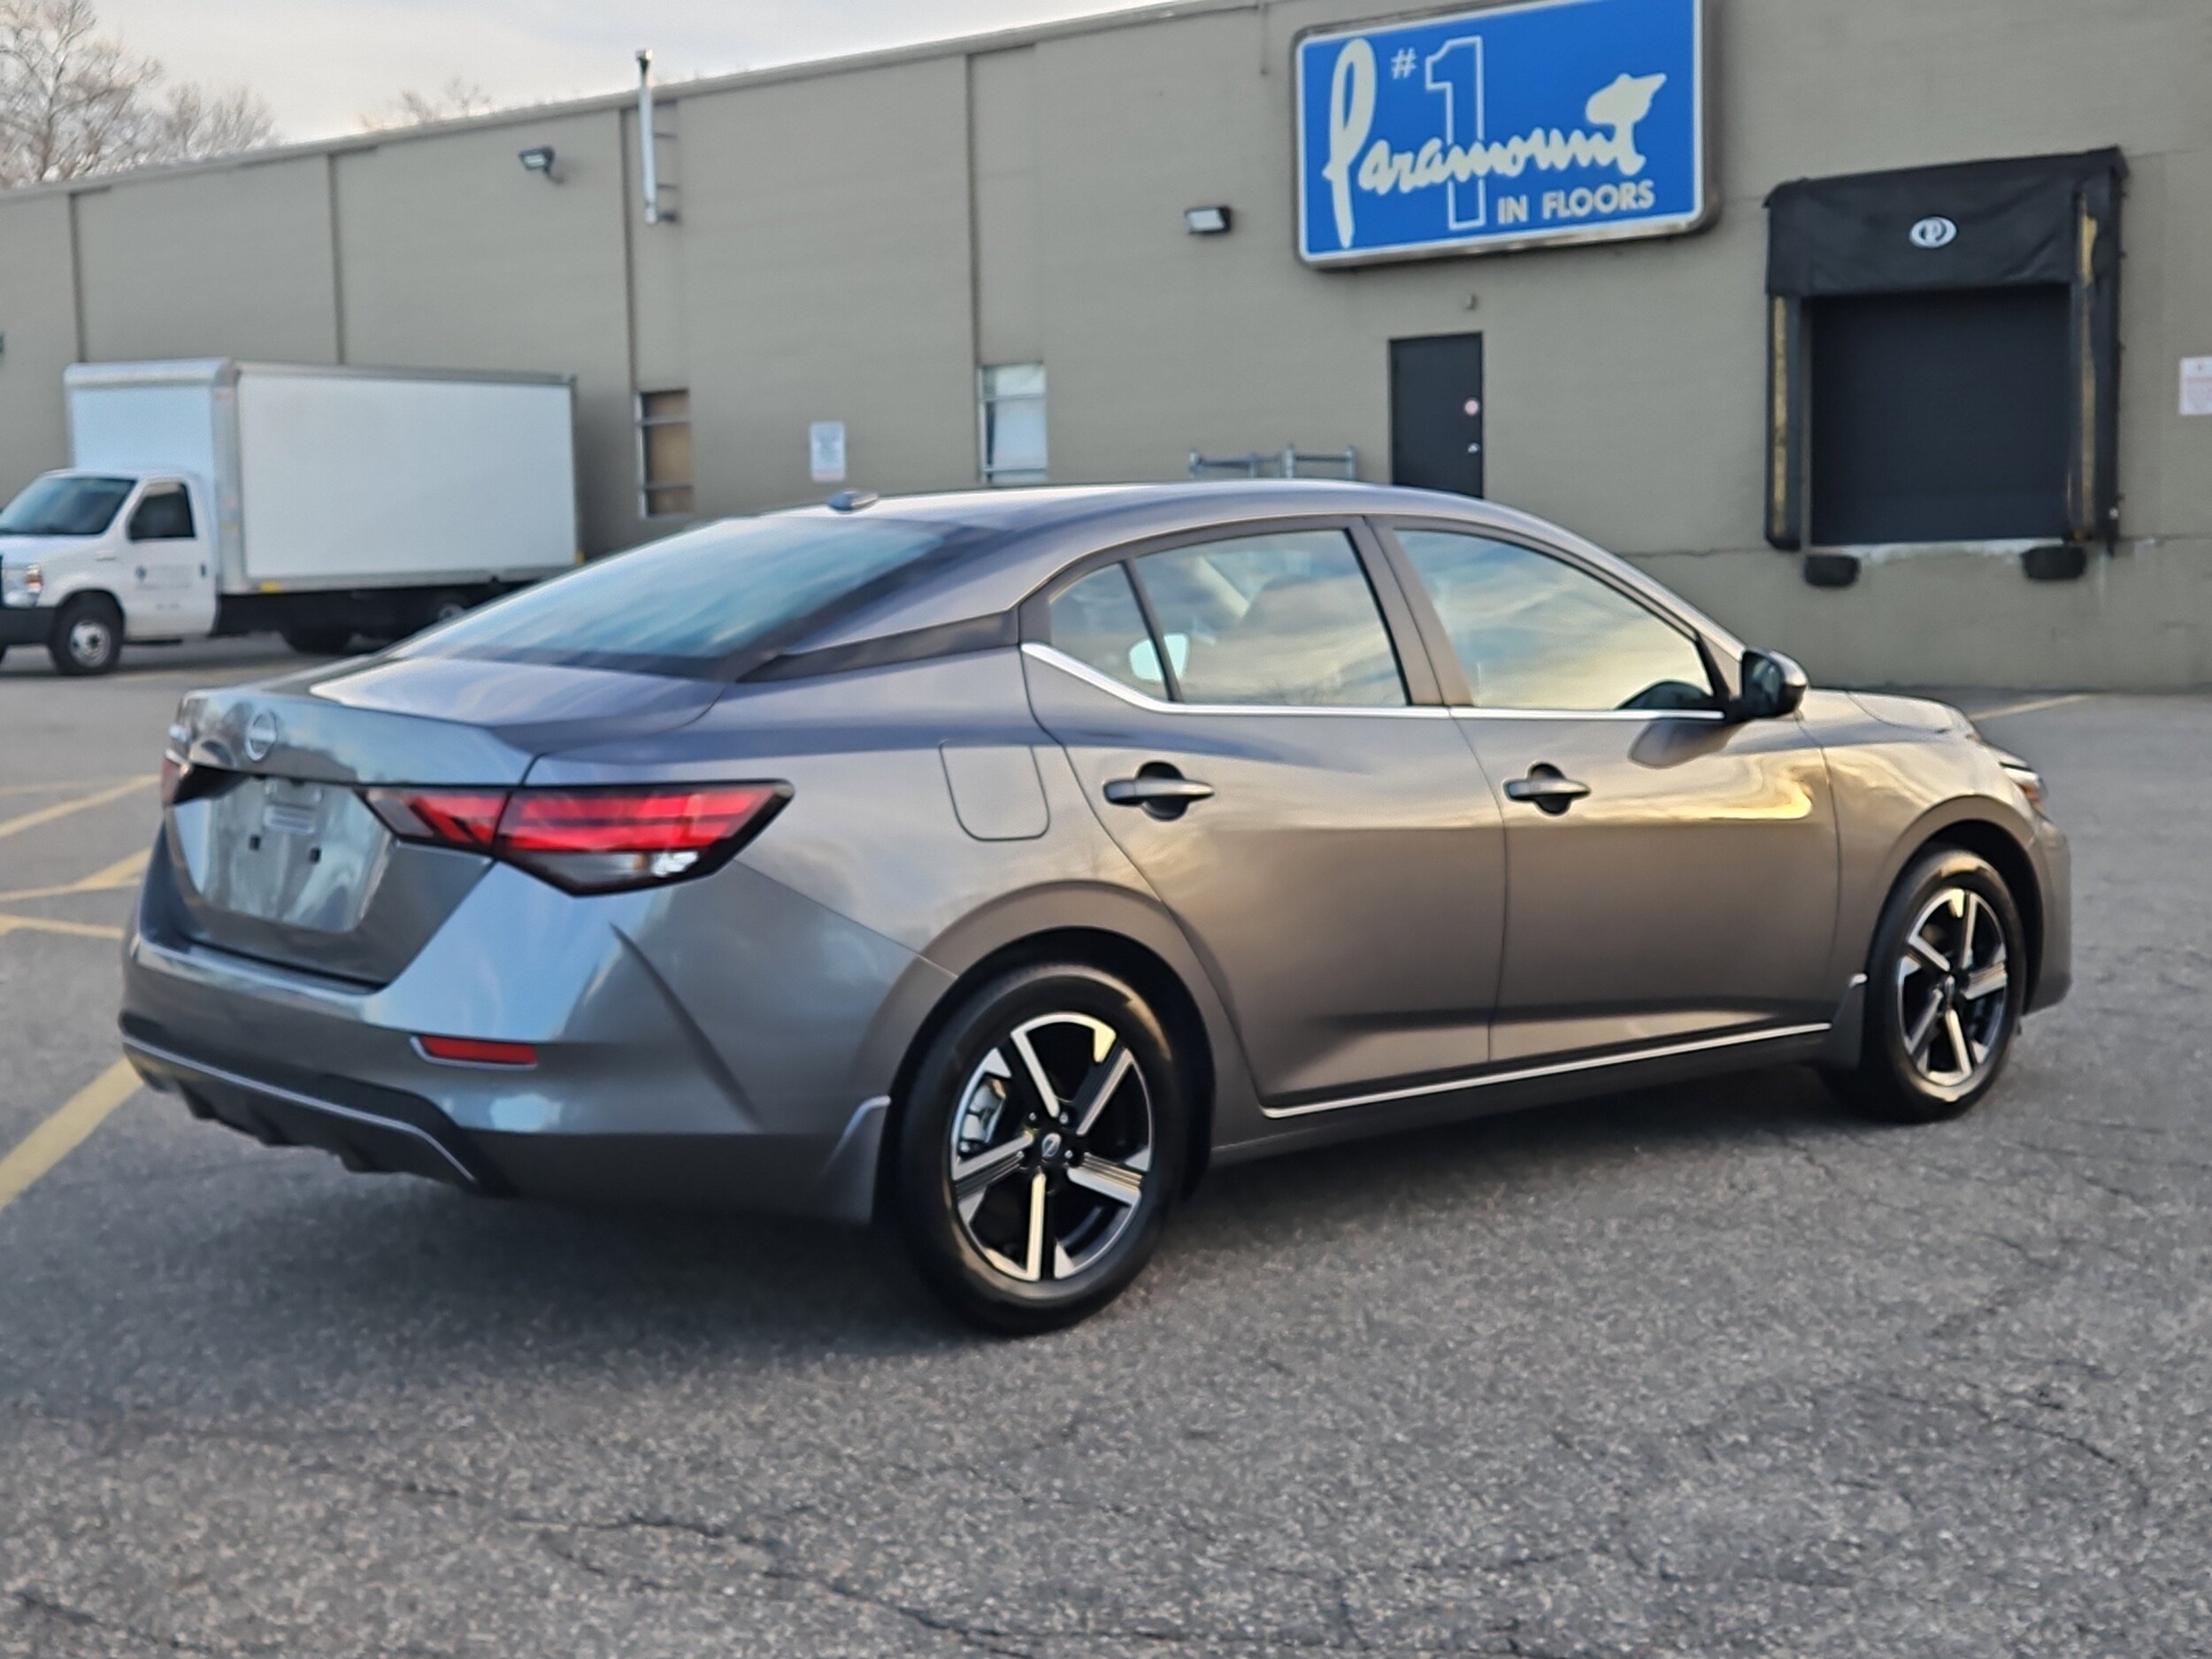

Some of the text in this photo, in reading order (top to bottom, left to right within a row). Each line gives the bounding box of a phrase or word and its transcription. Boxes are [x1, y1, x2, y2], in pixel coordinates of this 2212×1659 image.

[1323, 38, 1667, 249] Paramount
[1498, 180, 1655, 225] IN FLOORS
